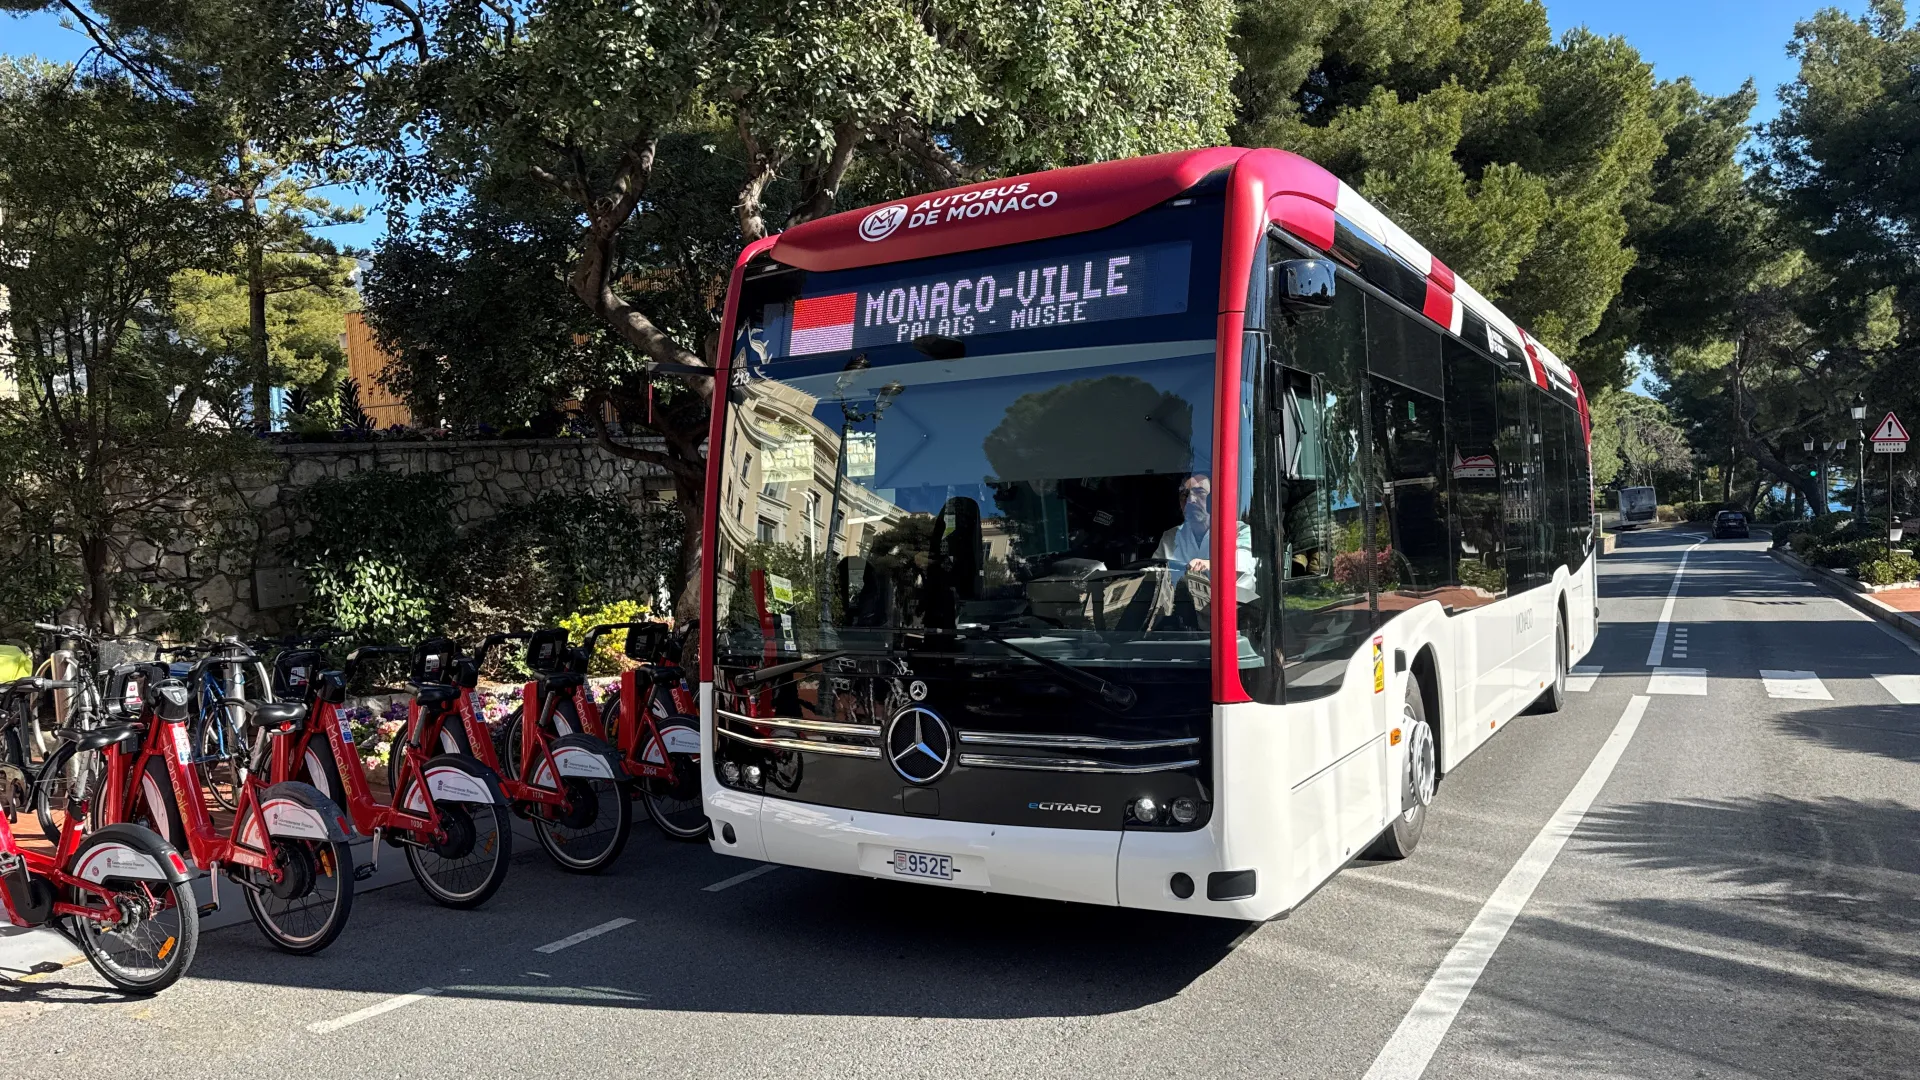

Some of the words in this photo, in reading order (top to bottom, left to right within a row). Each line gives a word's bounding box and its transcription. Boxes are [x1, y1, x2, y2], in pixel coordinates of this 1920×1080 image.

[908, 209, 941, 228] DE
[945, 191, 1058, 222] MONACO
[914, 182, 1031, 211] AUTOBUS
[864, 255, 1130, 326] MONACO-VILLE
[1010, 301, 1088, 329] MUSEE
[732, 372, 750, 386] 213
[1028, 801, 1102, 814] eCITARO
[908, 854, 950, 877] 952E
